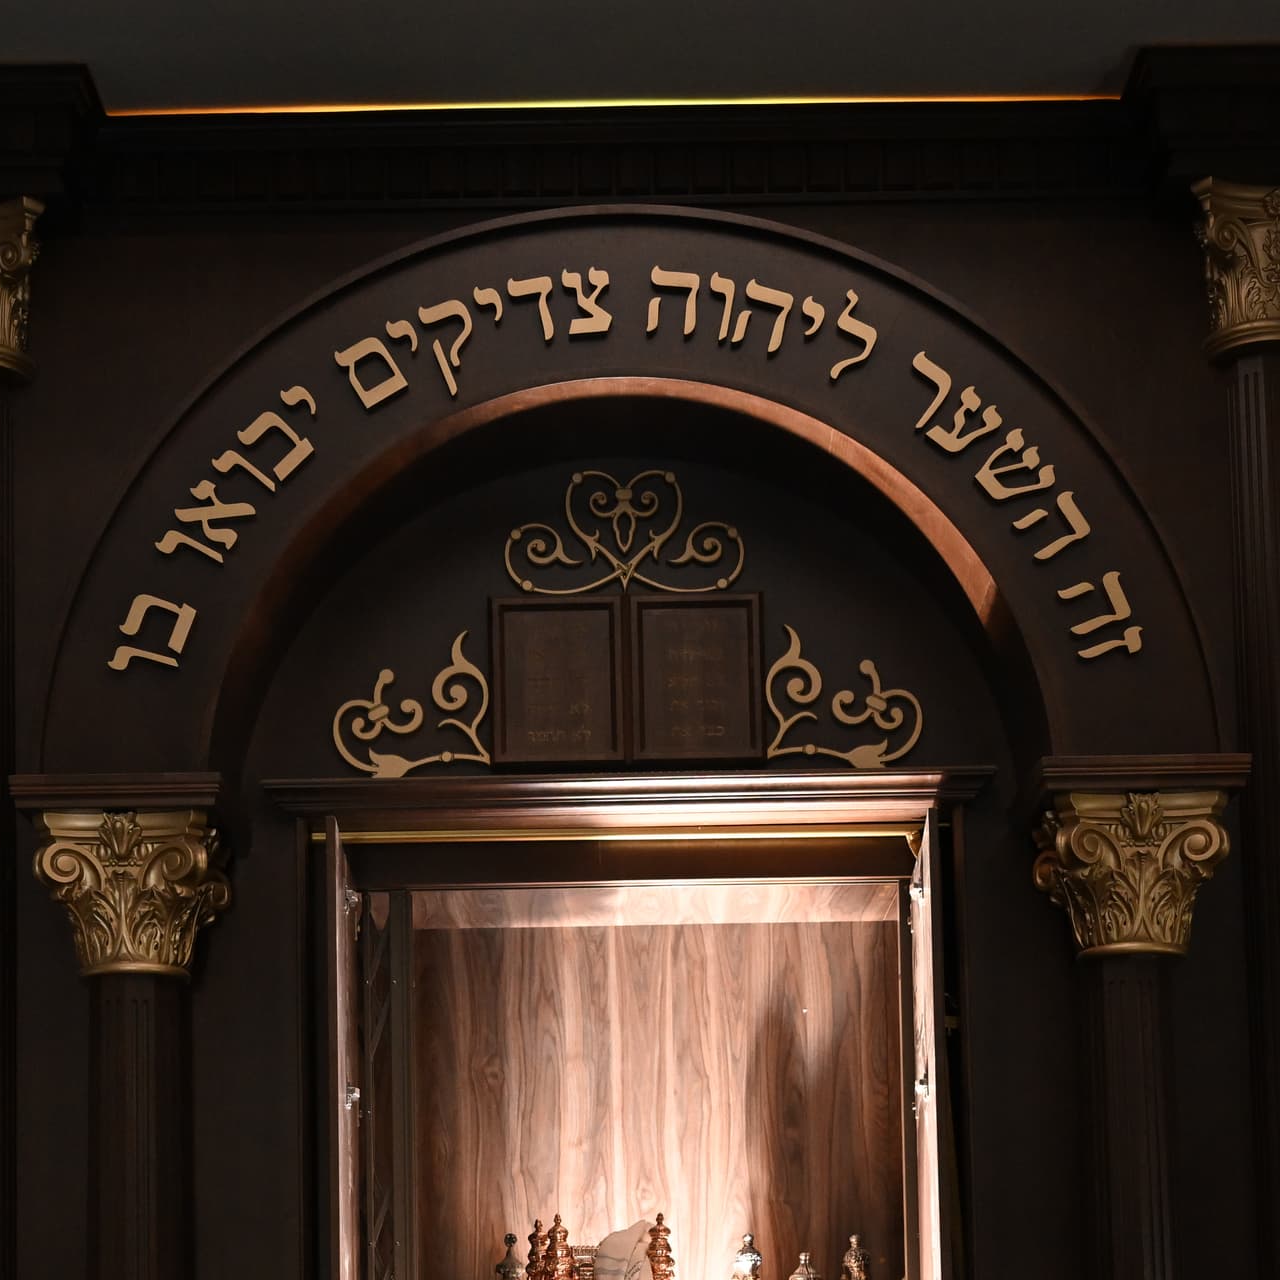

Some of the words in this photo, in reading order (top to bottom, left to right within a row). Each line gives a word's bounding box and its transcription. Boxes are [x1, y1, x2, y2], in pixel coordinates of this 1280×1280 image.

[334, 265, 613, 409] צדיקים
[646, 264, 878, 380] ליהוה
[154, 385, 317, 564] יבואו
[912, 350, 1091, 560] השער
[107, 593, 197, 671] בו
[1057, 571, 1143, 659] זה
